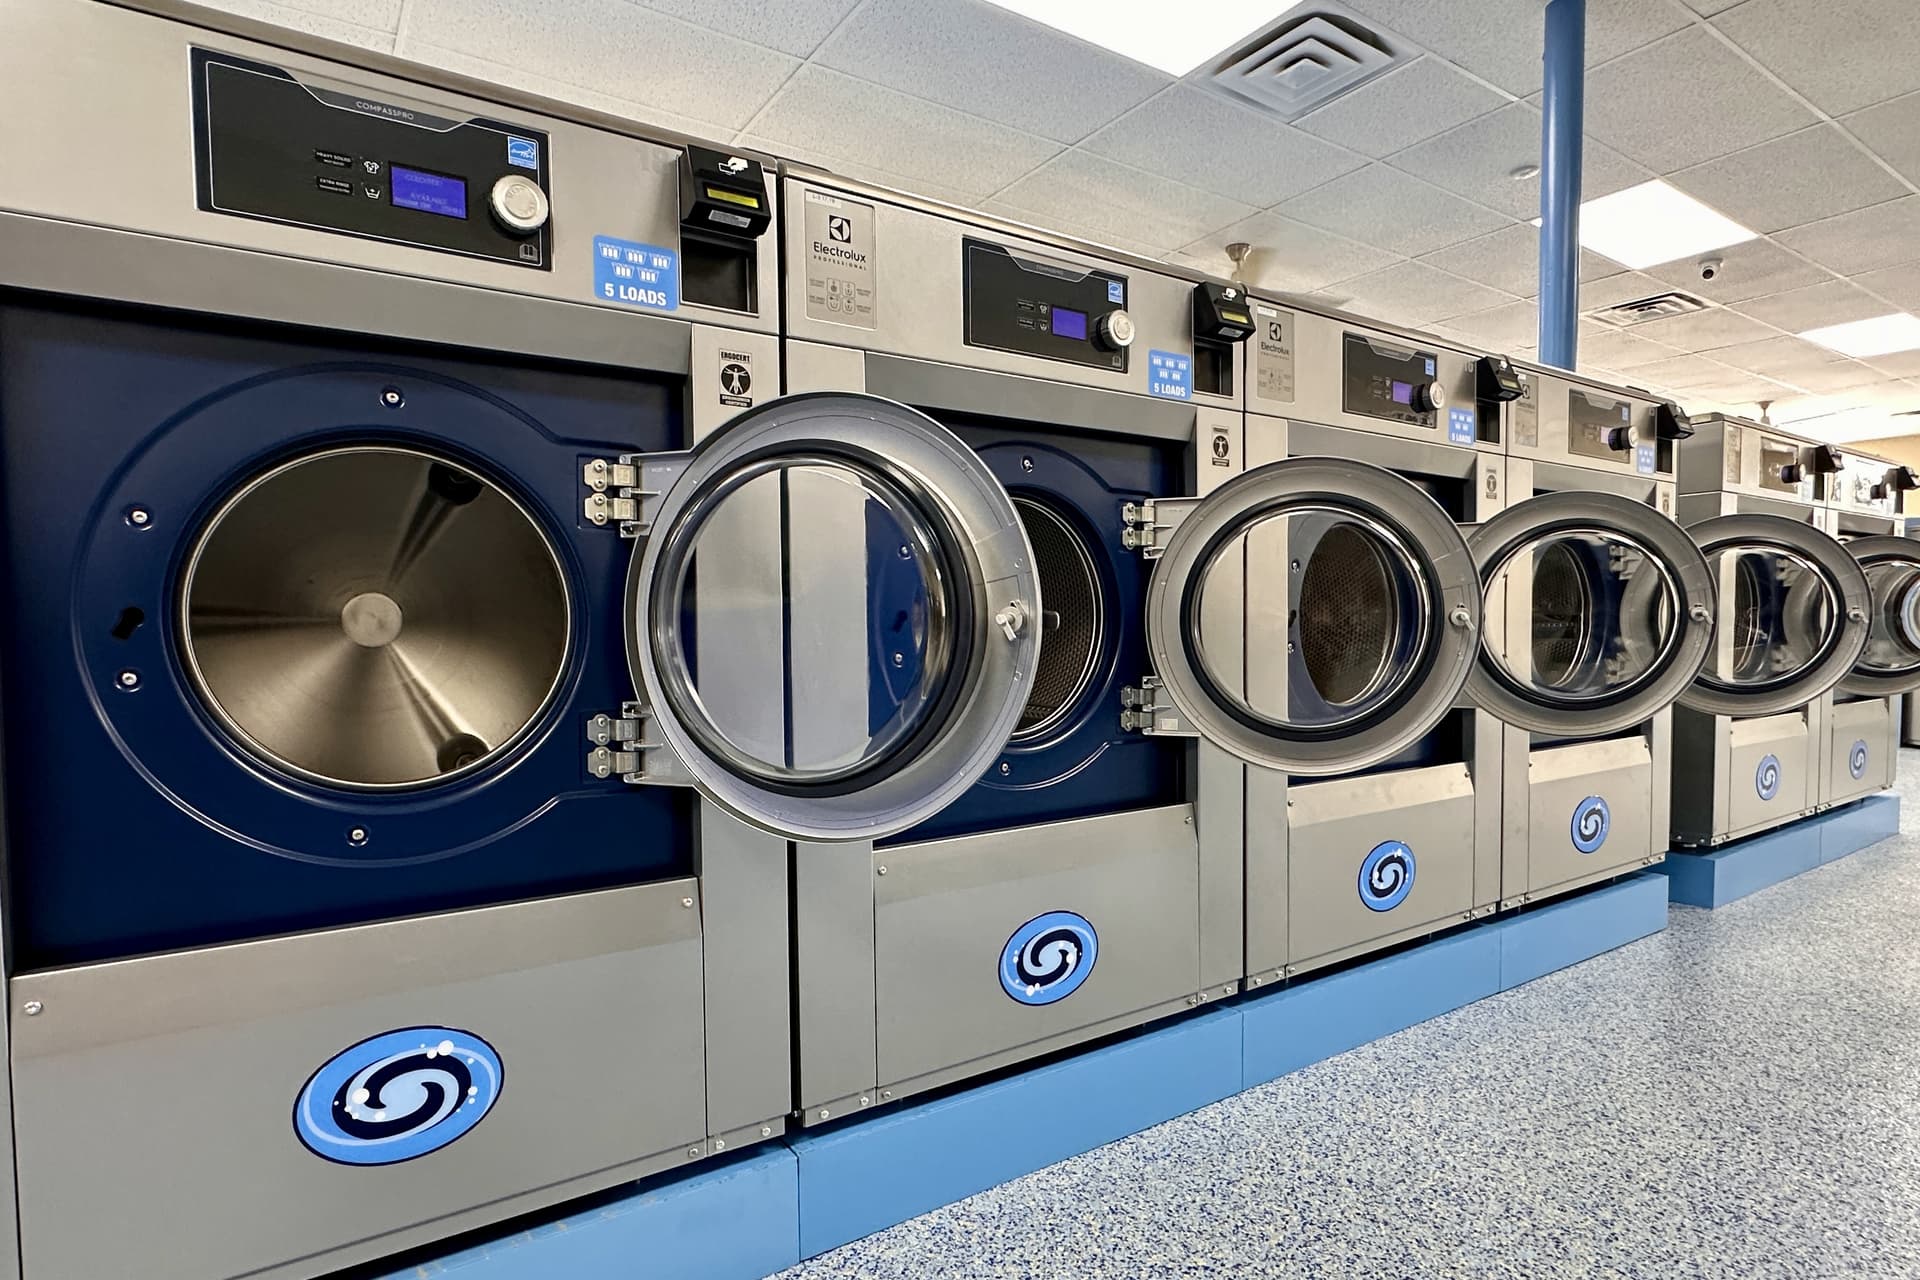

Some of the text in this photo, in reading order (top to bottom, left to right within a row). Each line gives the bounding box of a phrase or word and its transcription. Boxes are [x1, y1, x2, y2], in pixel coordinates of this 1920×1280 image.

[355, 100, 414, 120] COMPASSPRO
[813, 241, 866, 263] Electrolux
[604, 282, 667, 306] 5 LOADS
[1154, 382, 1186, 397] 5 LOADS
